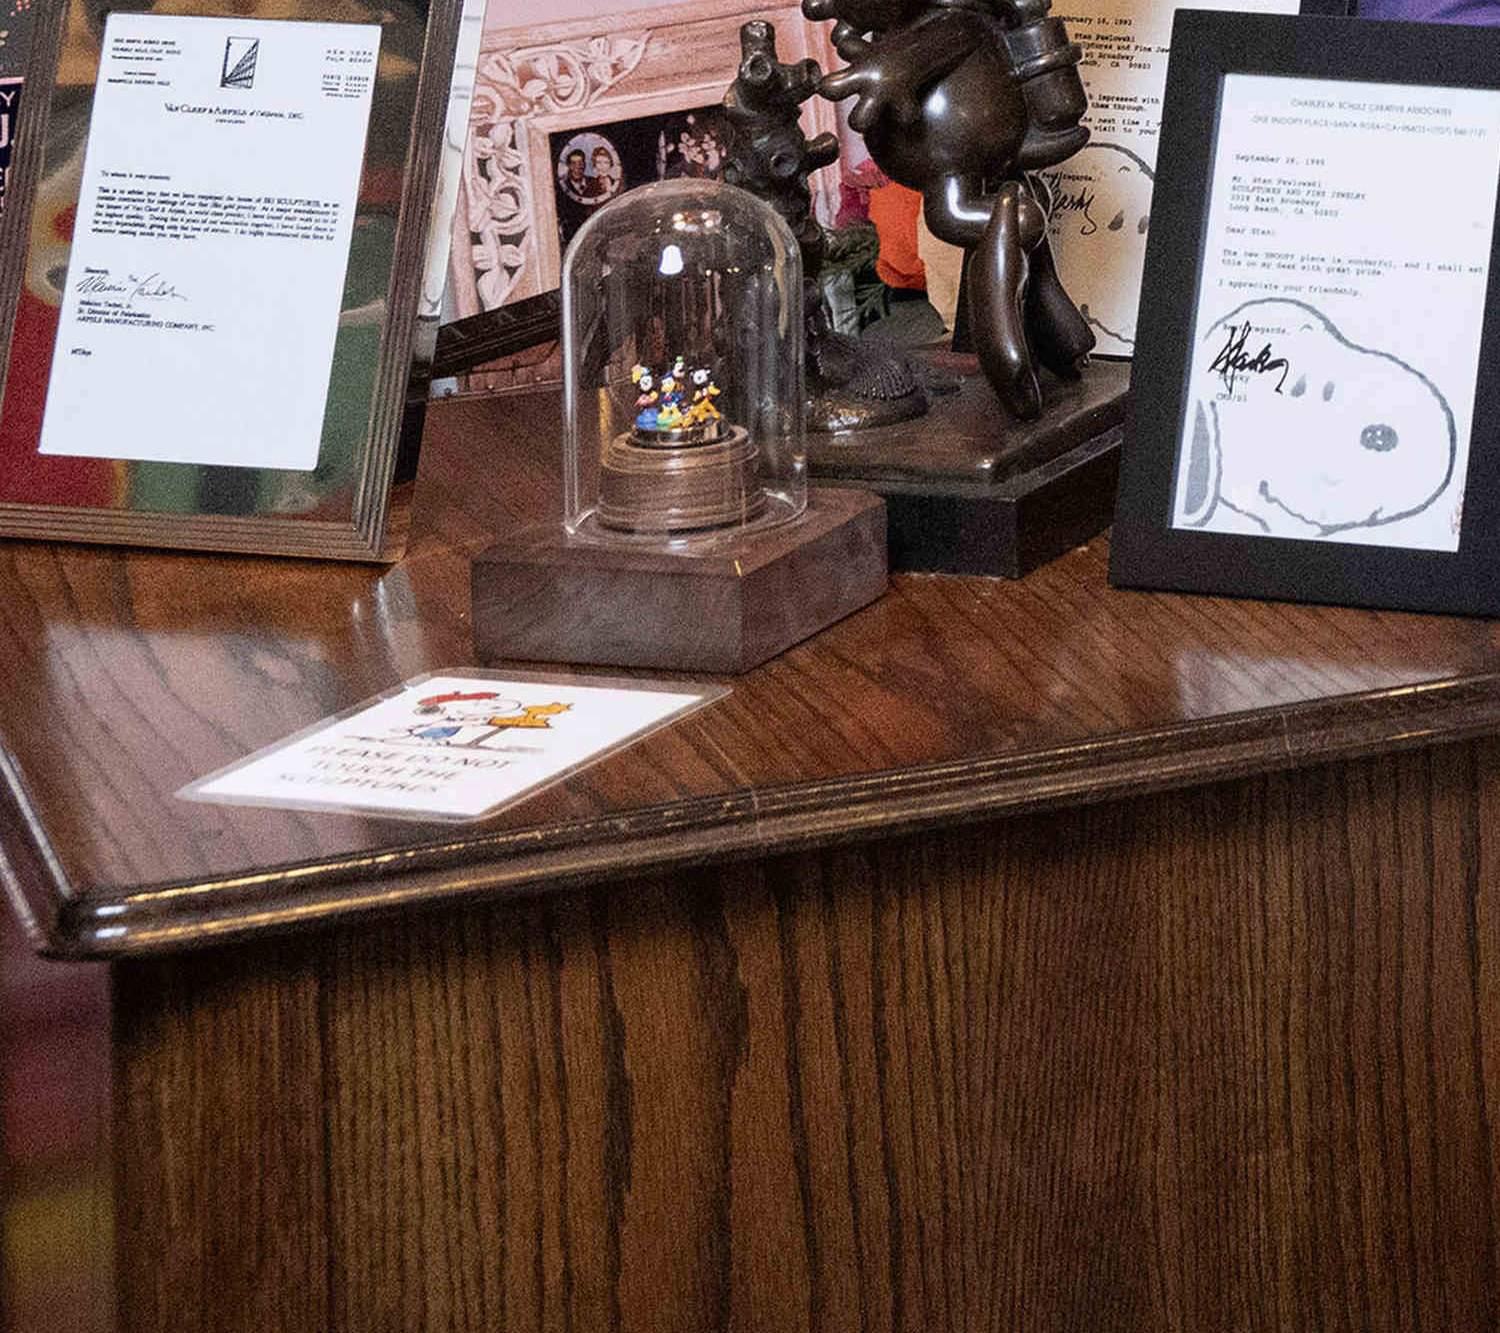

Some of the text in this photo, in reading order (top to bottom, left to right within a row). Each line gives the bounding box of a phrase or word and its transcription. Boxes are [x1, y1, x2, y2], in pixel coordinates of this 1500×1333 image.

[1117, 44, 1131, 52] and
[1098, 53, 1134, 61] Broadway
[1141, 96, 1159, 105] with
[1235, 153, 1280, 165] September
[1253, 177, 1273, 185] Stan
[1286, 187, 1302, 195] AND
[1306, 189, 1327, 197] FINE
[1256, 196, 1275, 204] East
[1226, 227, 1246, 235] Dear
[1223, 249, 1239, 257] The
[1265, 252, 1295, 261] SNOOPY
[1300, 255, 1326, 265] piece
[1404, 262, 1420, 270] and
[1438, 265, 1462, 273] shall
[1301, 264, 1321, 273] with
[1327, 265, 1352, 275] great
[1356, 268, 1384, 278] pride.
[1229, 281, 1279, 292] appreciate
[1284, 284, 1304, 294] your
[307, 745, 514, 772] PLEASE DO NOT
[410, 769, 459, 782] THE
